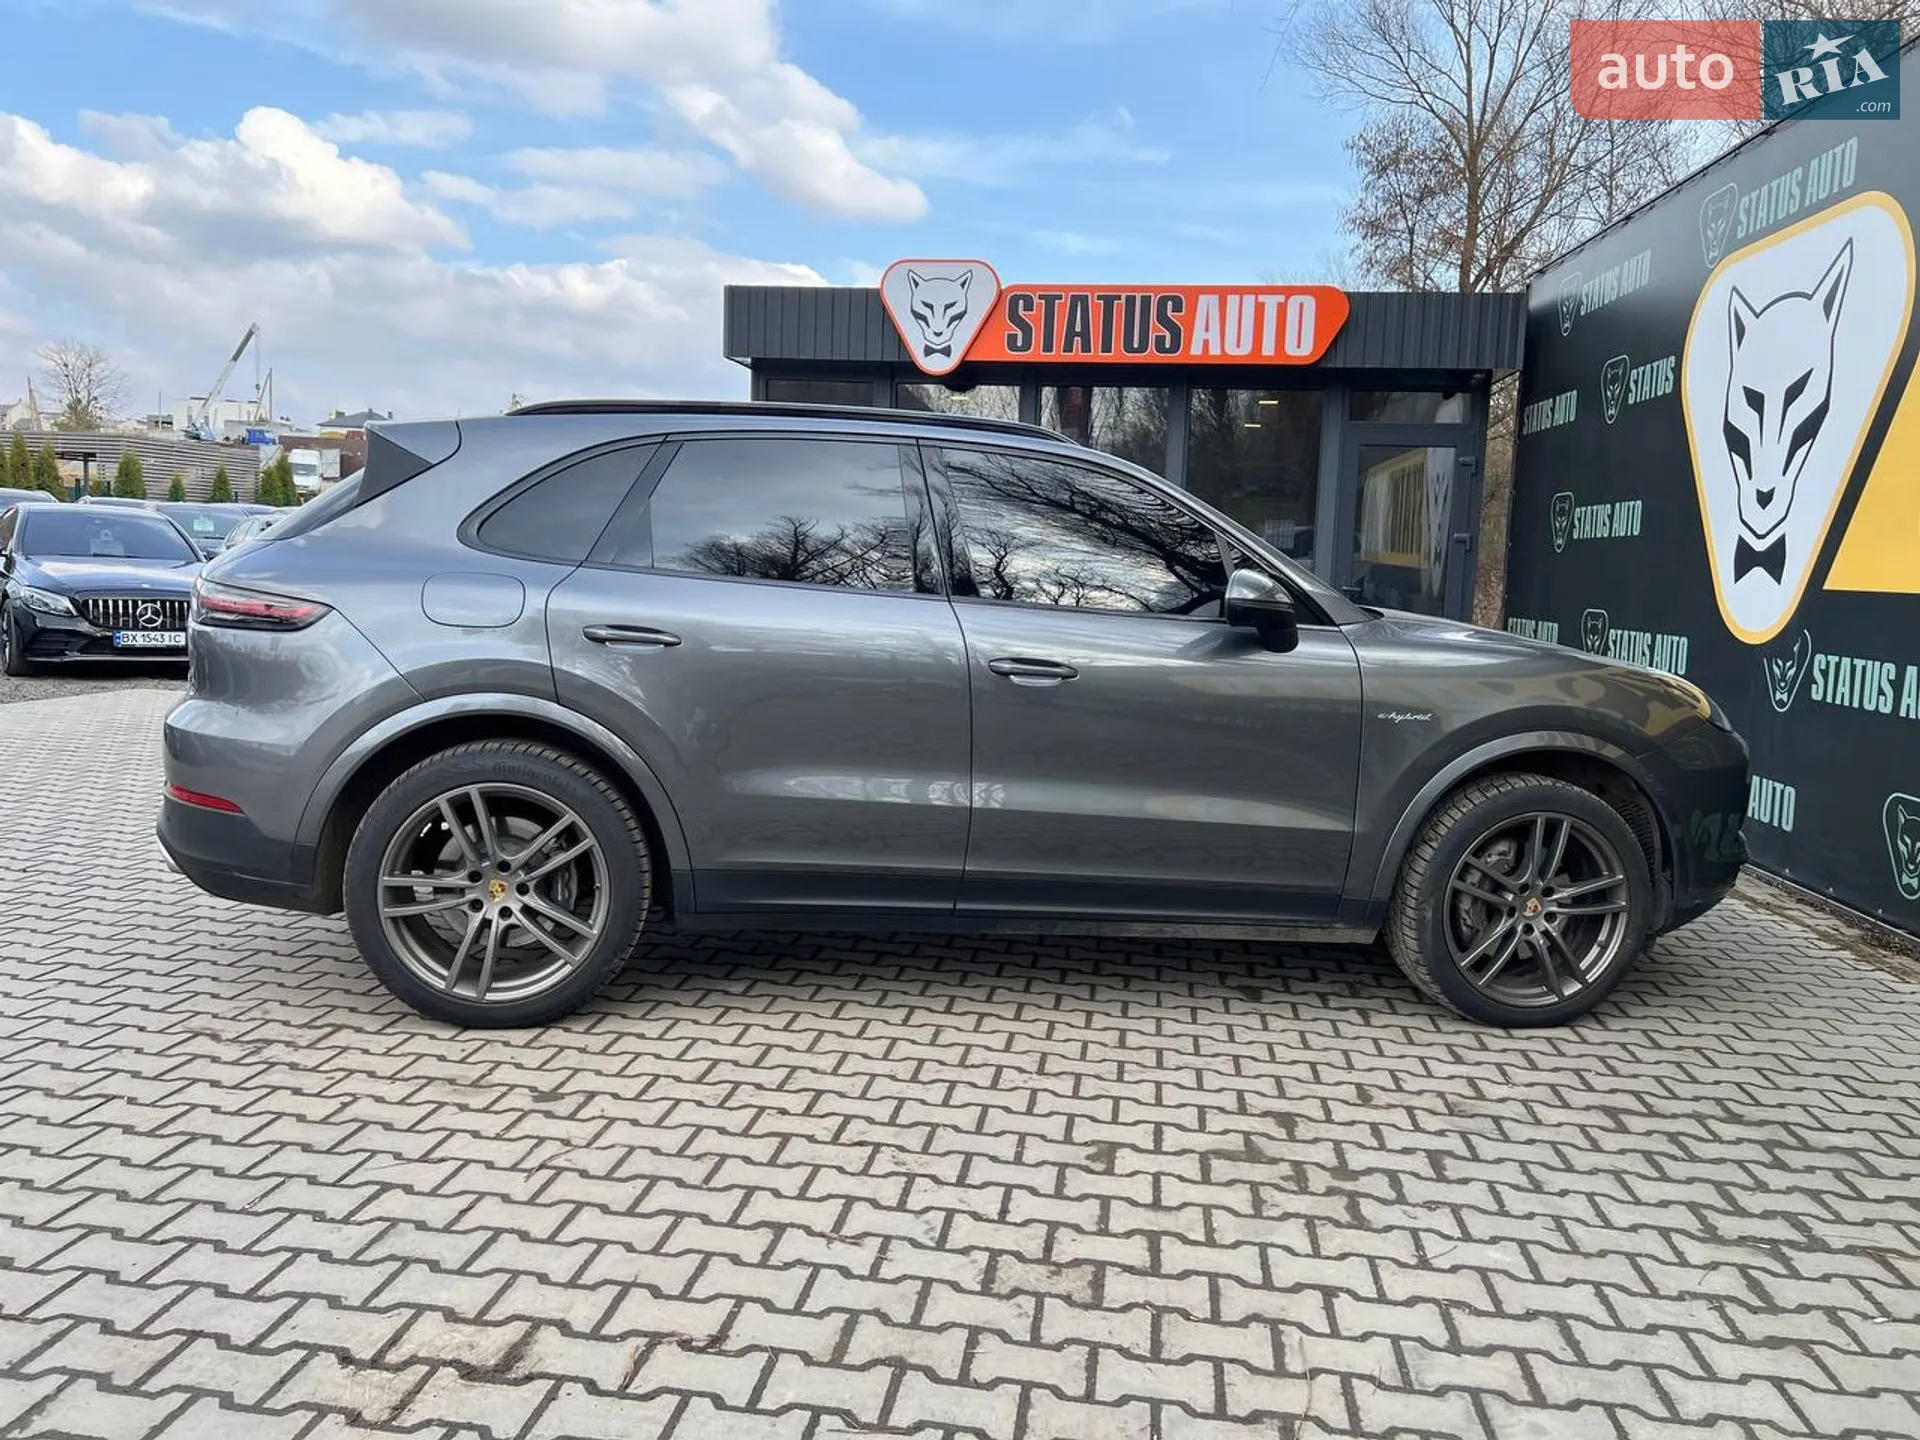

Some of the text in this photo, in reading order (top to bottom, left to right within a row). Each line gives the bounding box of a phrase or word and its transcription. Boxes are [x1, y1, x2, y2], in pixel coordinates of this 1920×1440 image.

[1736, 136, 1858, 239] STATUS AUTO
[1580, 248, 1652, 316] STATUS AUTO
[1004, 292, 1316, 356] STATUS AUTO
[1628, 355, 1675, 405] STATUS
[1523, 389, 1578, 436] STATUS AUTO
[1573, 499, 1642, 540] STATUS AUTO
[121, 633, 138, 643] BX
[140, 633, 165, 643] 1543
[168, 634, 182, 643] IC
[1607, 628, 1689, 676] STATUS AUTO
[1811, 653, 1920, 720] STATUS A
[1747, 774, 1796, 832] AUTO
